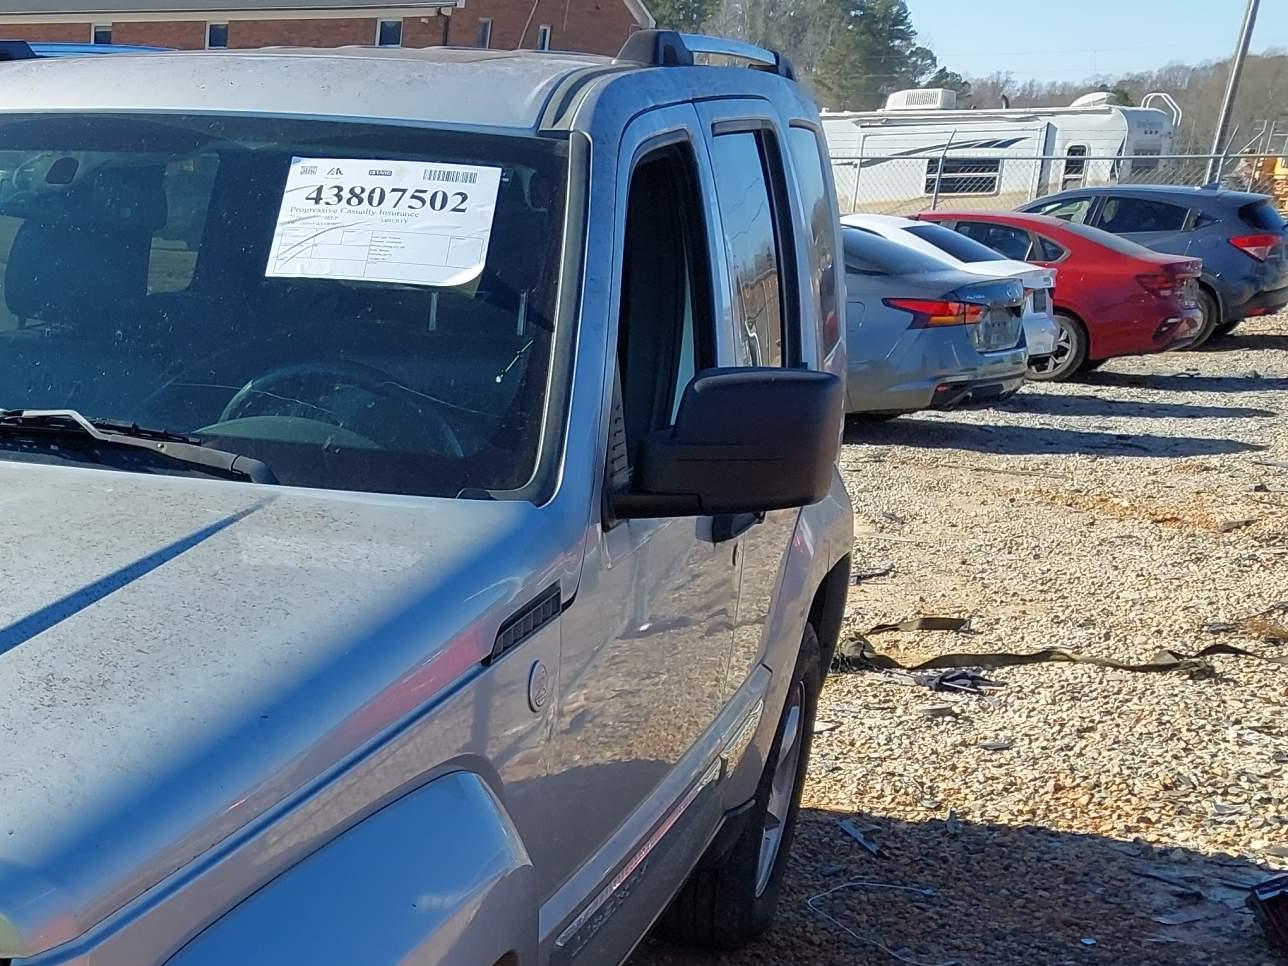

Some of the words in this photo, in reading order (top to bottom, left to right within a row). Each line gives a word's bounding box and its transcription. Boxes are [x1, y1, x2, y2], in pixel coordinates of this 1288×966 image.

[305, 184, 469, 213] 43807502
[290, 206, 338, 215] Progressive
[340, 207, 377, 217] Casualty
[379, 208, 420, 218] Insurance
